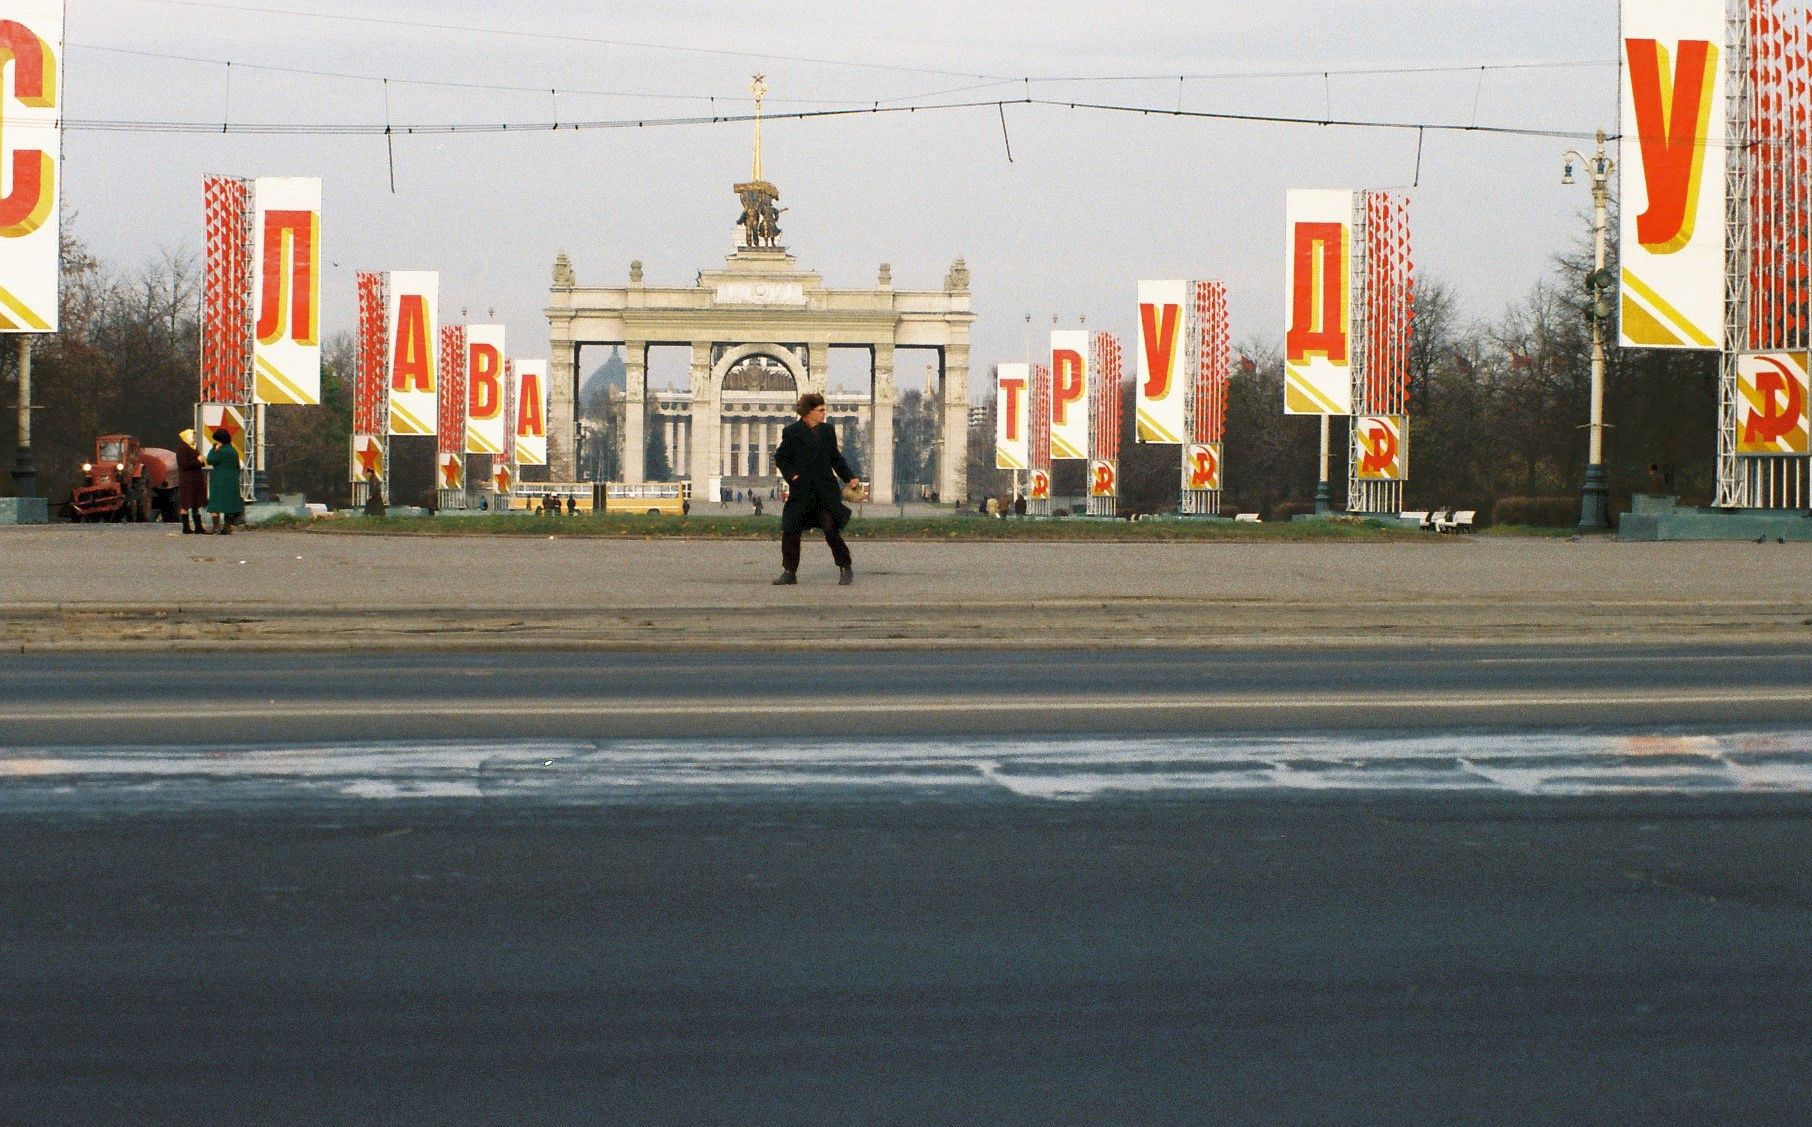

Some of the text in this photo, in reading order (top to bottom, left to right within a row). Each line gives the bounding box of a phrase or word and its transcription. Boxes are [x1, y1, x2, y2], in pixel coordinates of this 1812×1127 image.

[1625, 38, 1719, 255] У
[256, 210, 319, 346] Л
[1286, 222, 1349, 367] Д
[392, 295, 436, 393] А
[469, 343, 503, 421] В
[1053, 350, 1085, 425] Р
[1140, 304, 1183, 400] У
[517, 375, 545, 437] А
[1000, 379, 1027, 441] Т
